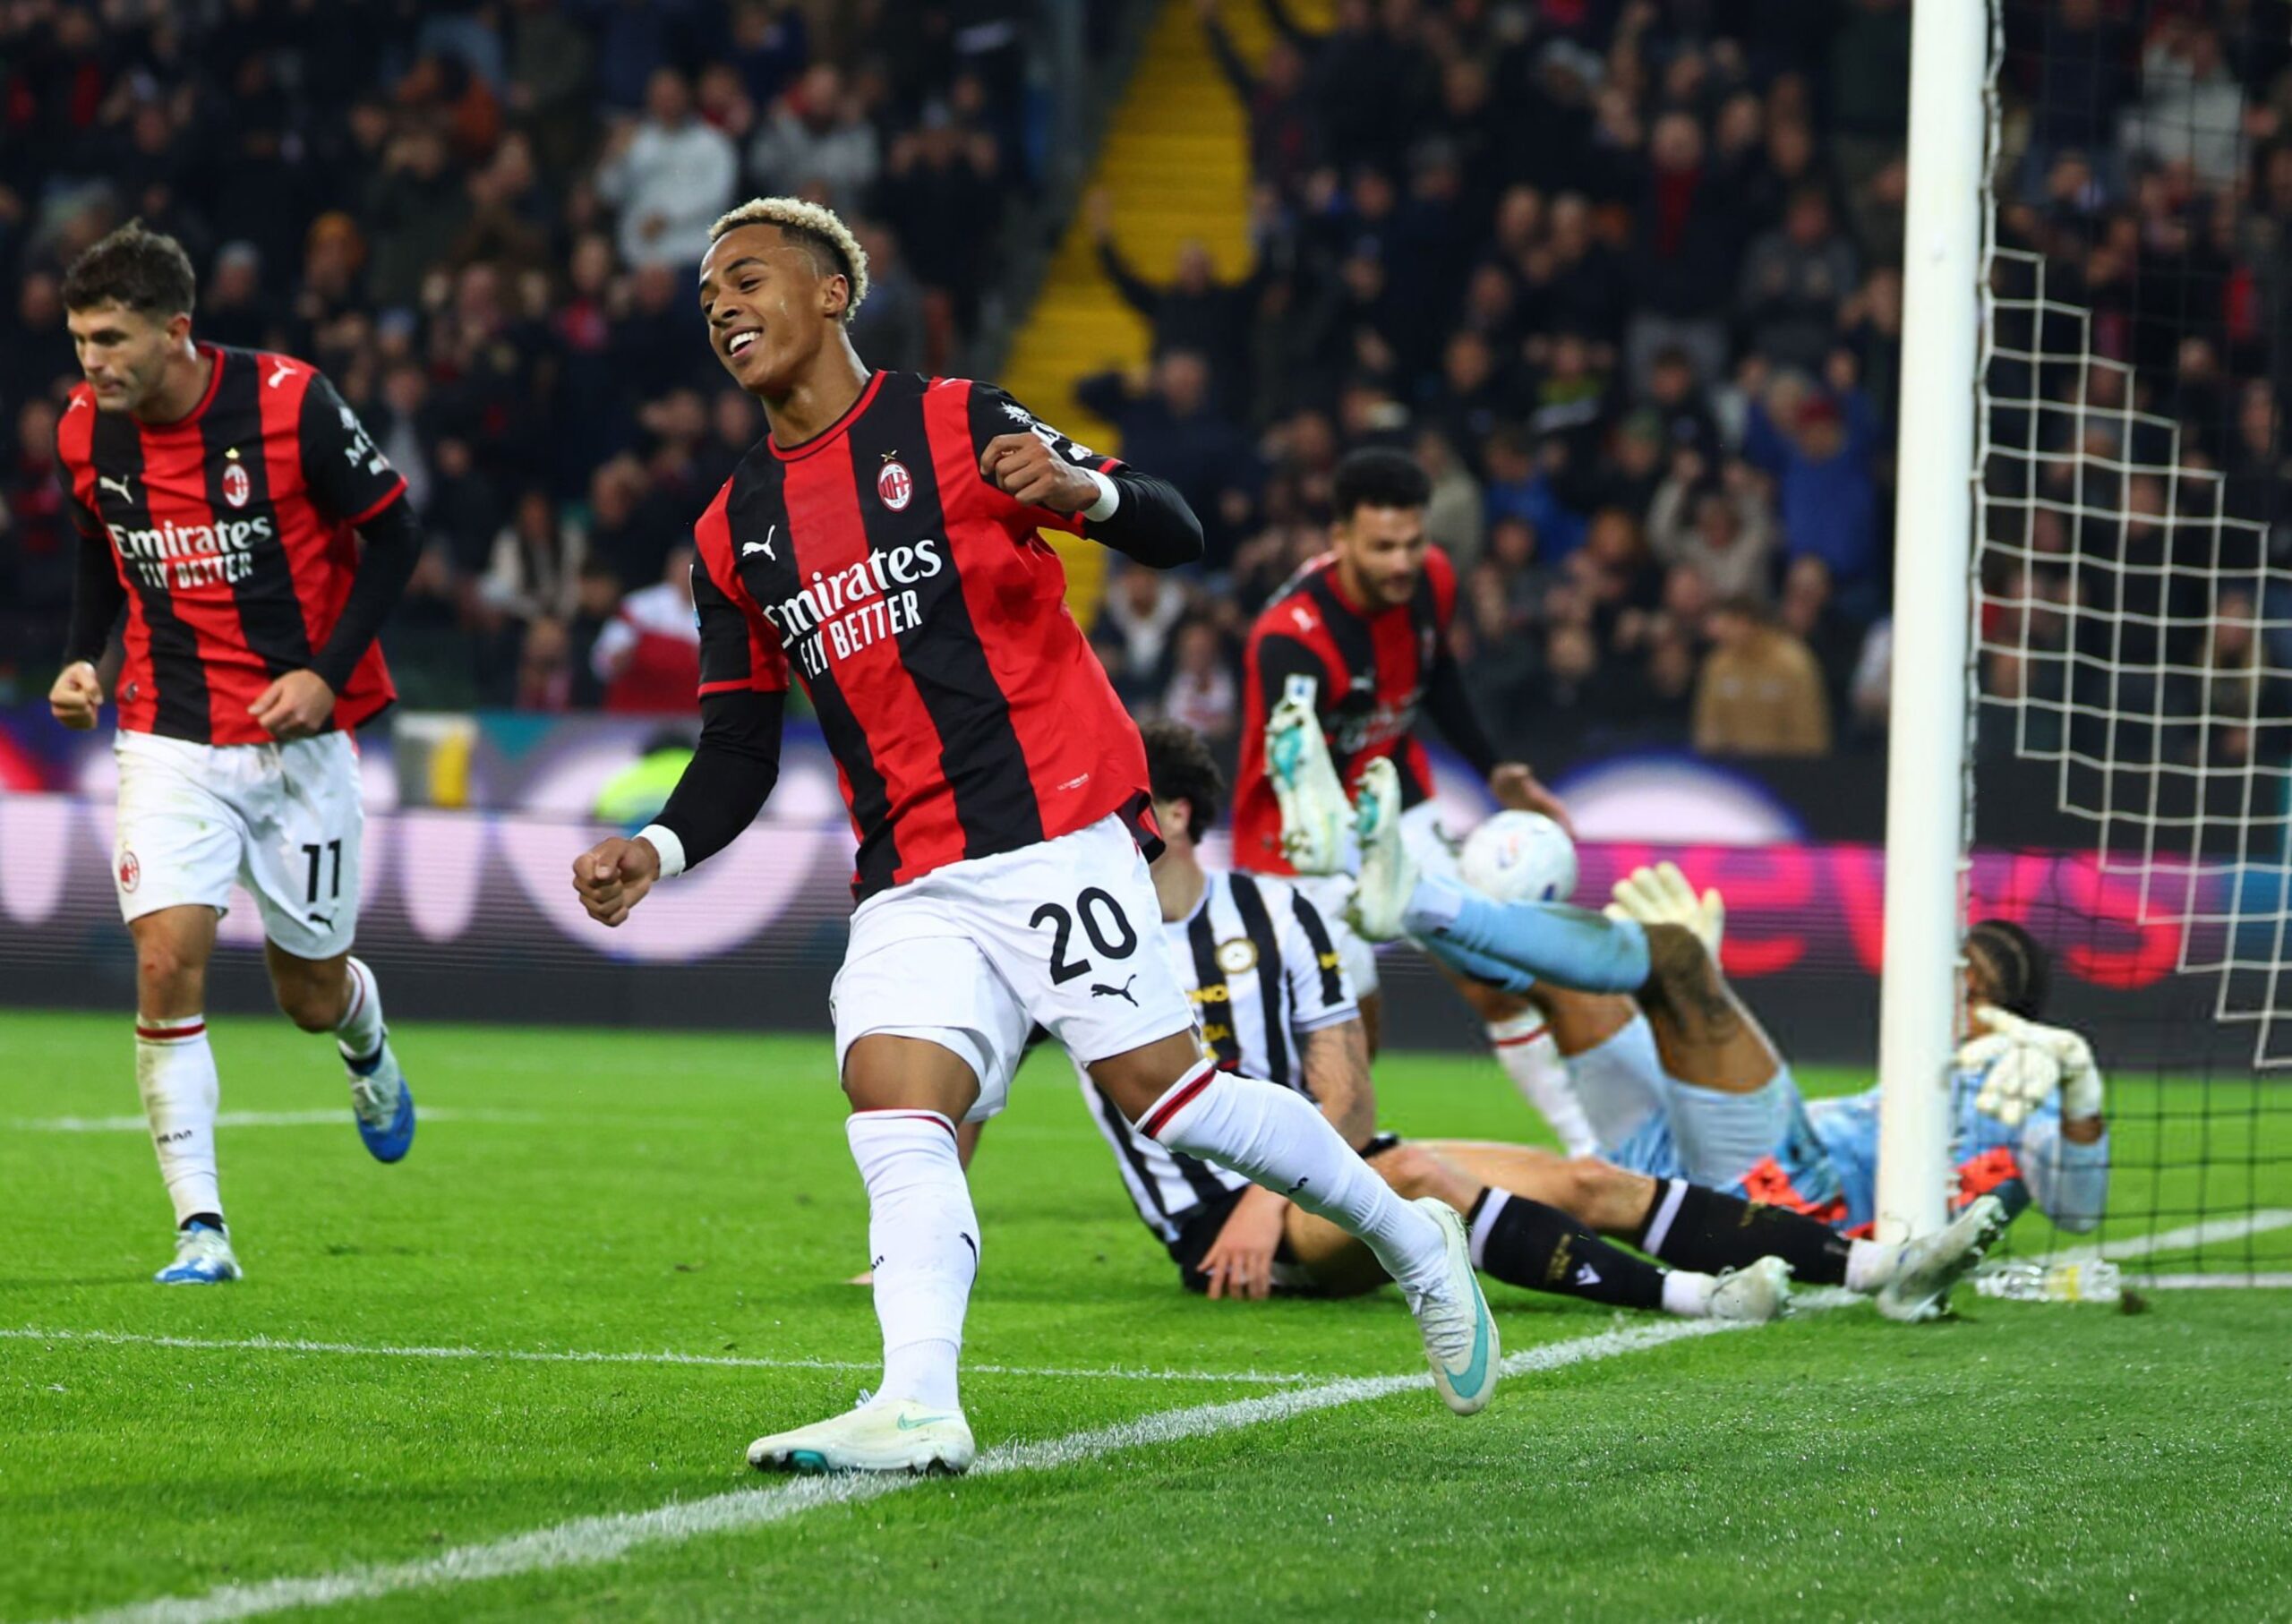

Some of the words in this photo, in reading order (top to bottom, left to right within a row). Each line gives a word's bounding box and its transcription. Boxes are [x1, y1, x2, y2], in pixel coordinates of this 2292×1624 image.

[107, 517, 272, 560] Emirates
[175, 551, 253, 589] BETTER
[763, 539, 942, 649] Emirates
[800, 630, 829, 680] FLY
[828, 589, 923, 660] BETTER
[302, 839, 341, 902] 11
[1029, 886, 1137, 986] 20
